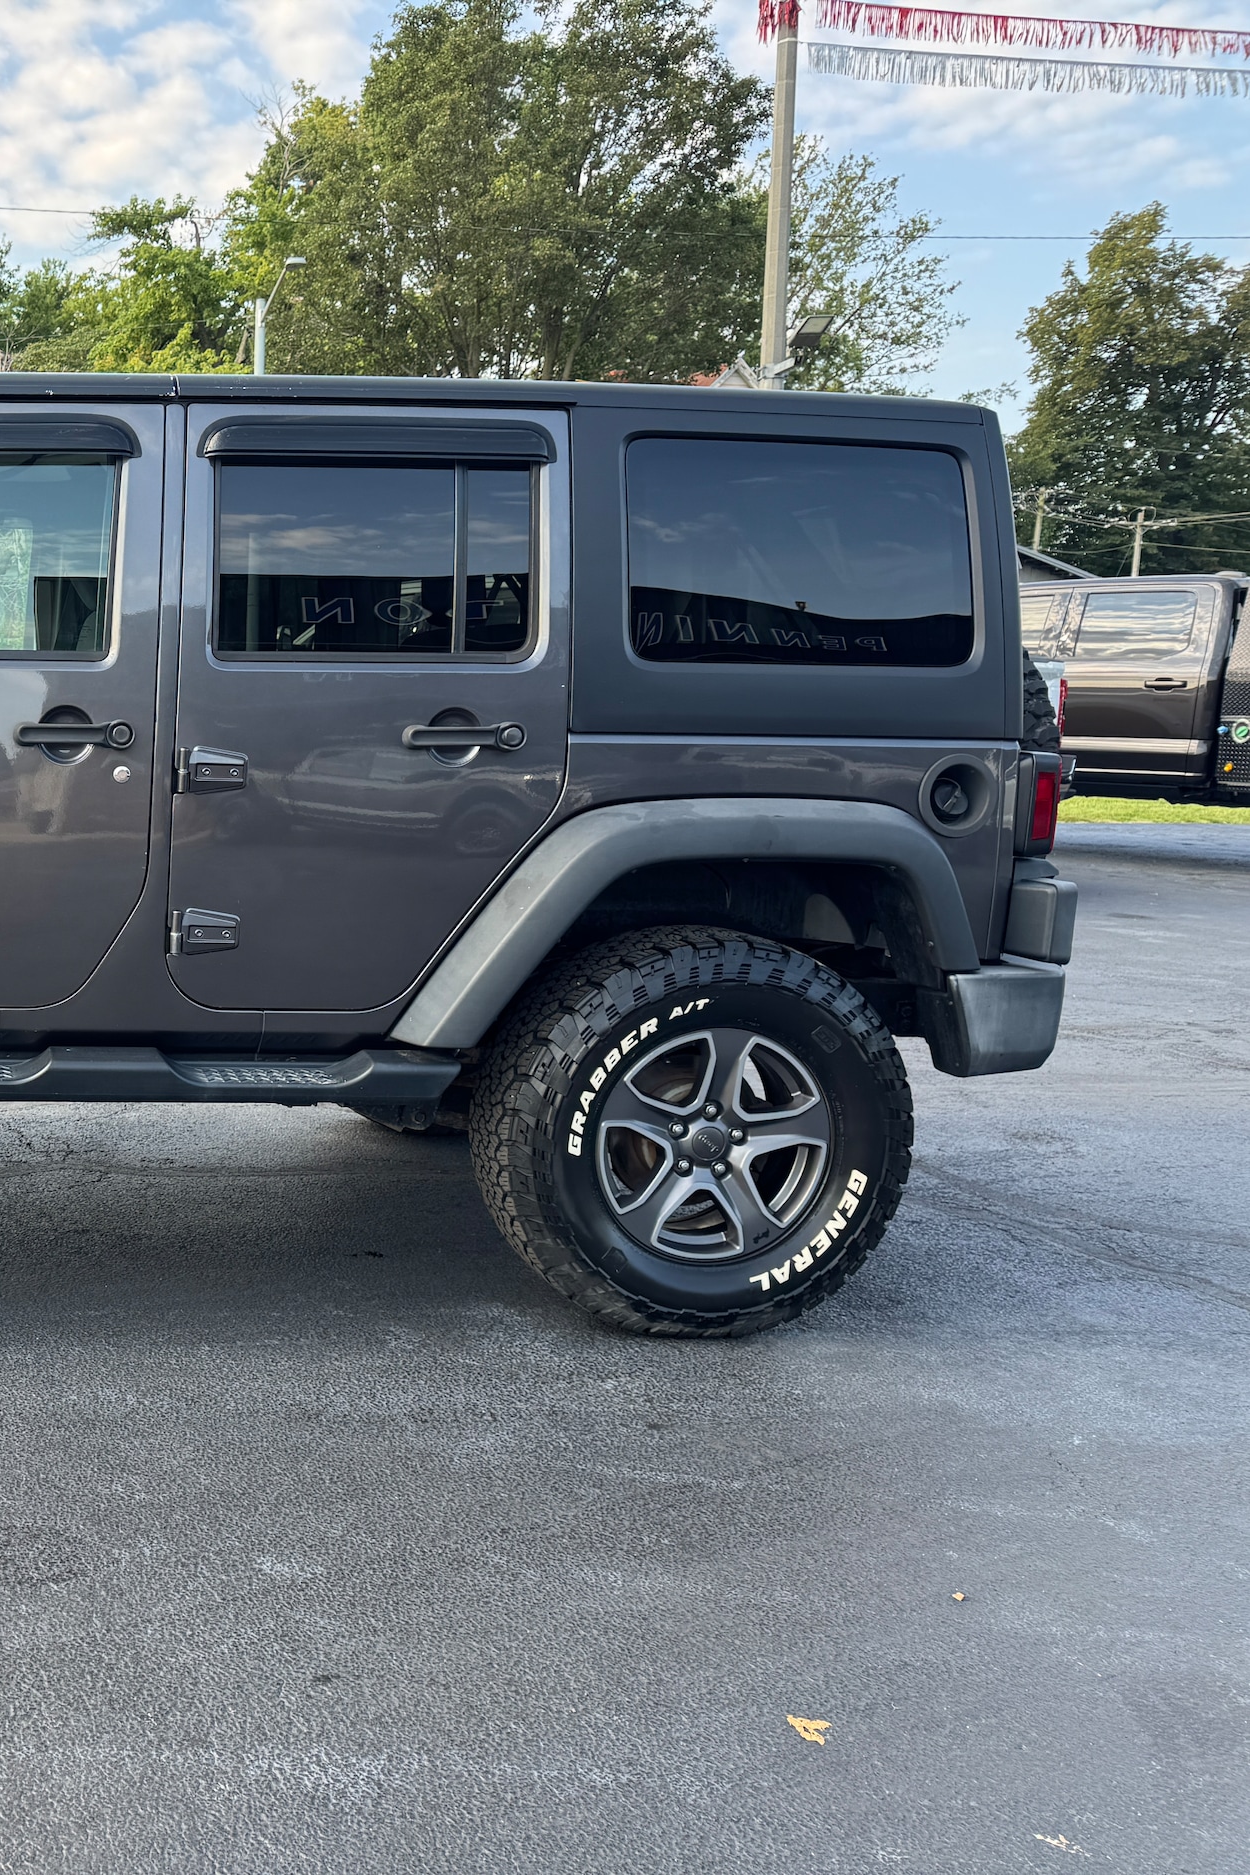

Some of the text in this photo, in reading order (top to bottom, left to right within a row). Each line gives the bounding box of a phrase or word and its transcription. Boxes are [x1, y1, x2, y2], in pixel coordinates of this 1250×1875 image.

[568, 998, 710, 1157] GRABBER A/T
[749, 1169, 868, 1291] GENERAL
